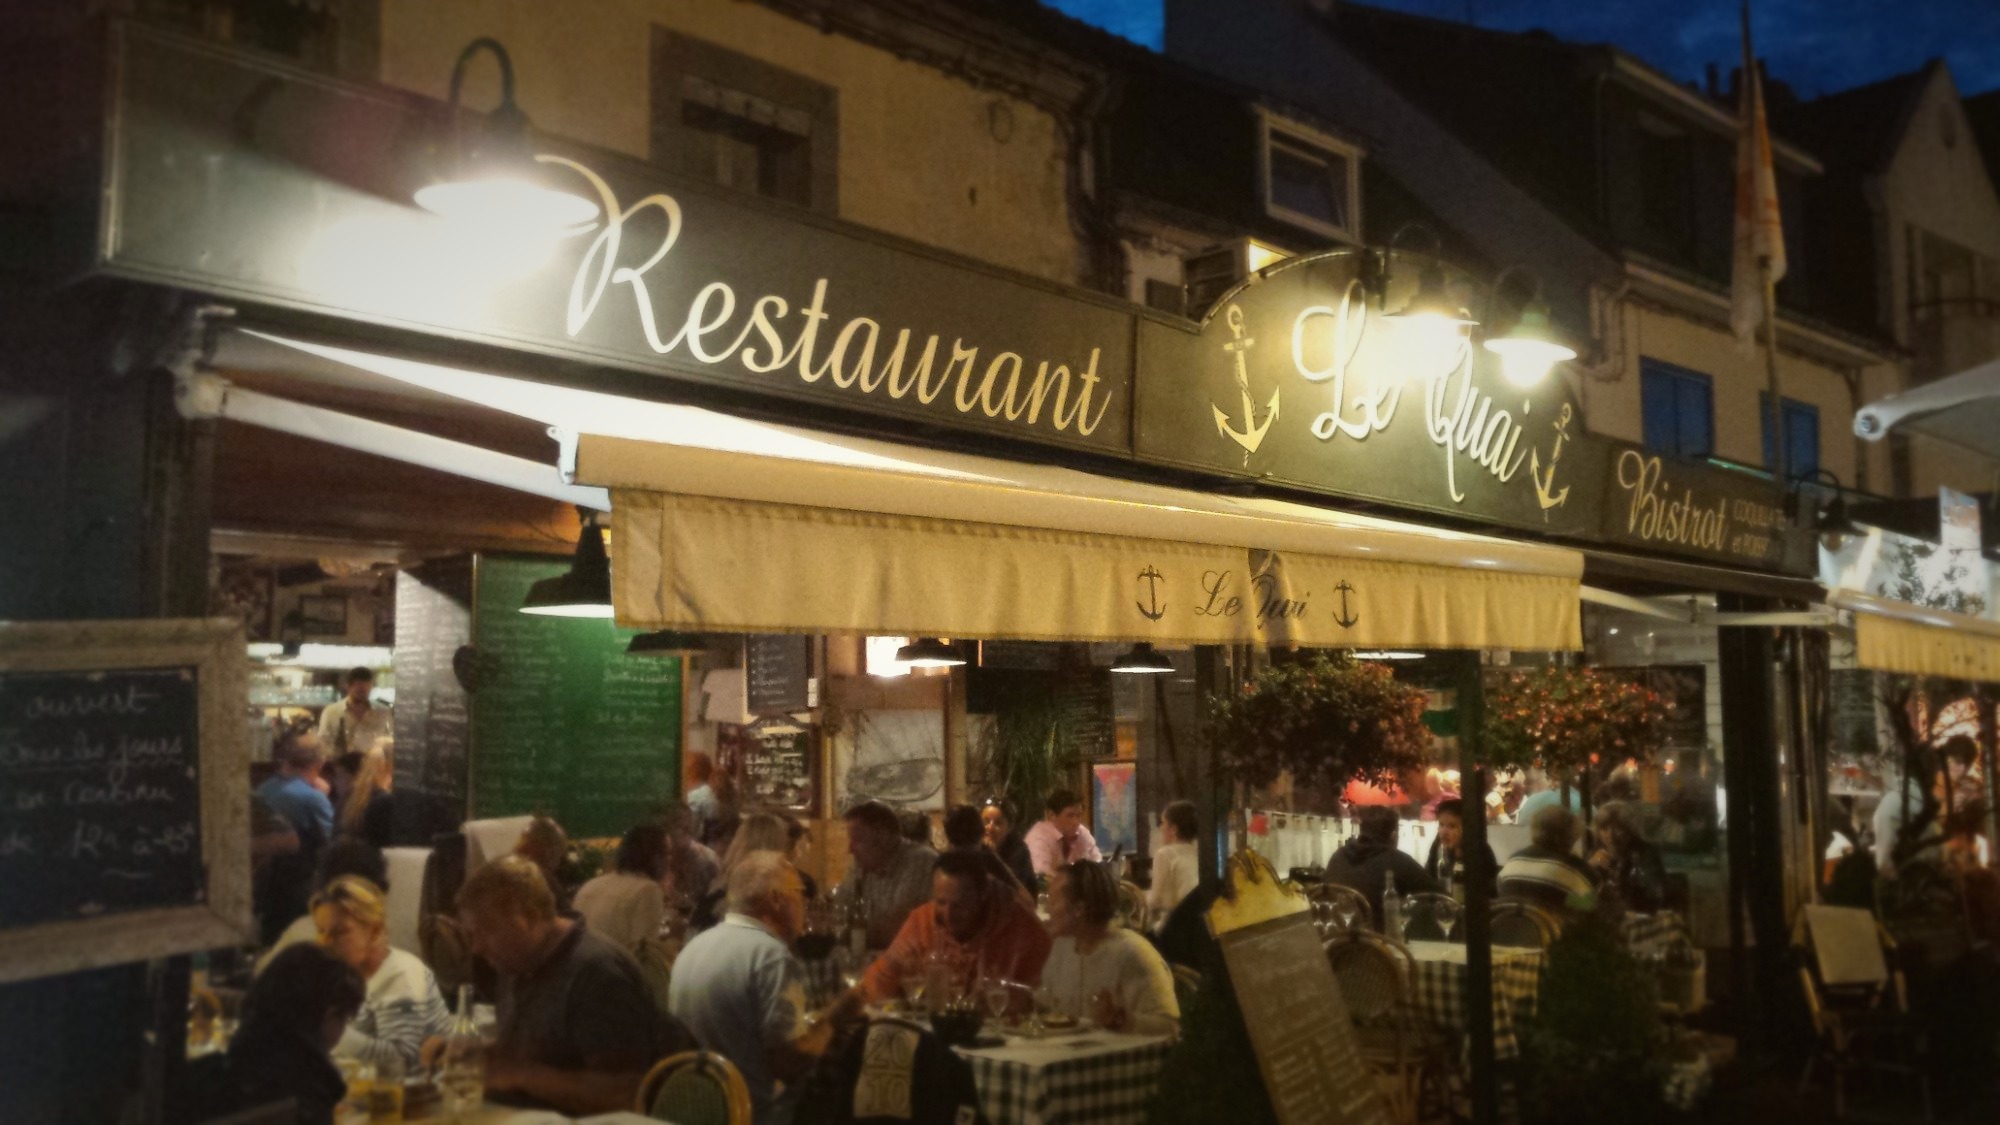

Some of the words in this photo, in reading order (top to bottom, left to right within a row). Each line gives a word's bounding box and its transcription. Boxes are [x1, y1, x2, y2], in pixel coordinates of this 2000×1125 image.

[536, 154, 1112, 437] Restaurant
[1292, 279, 1402, 440] Le
[1425, 310, 1530, 503] Quai
[1618, 450, 1728, 551] Bistrot
[1194, 570, 1244, 617] Le
